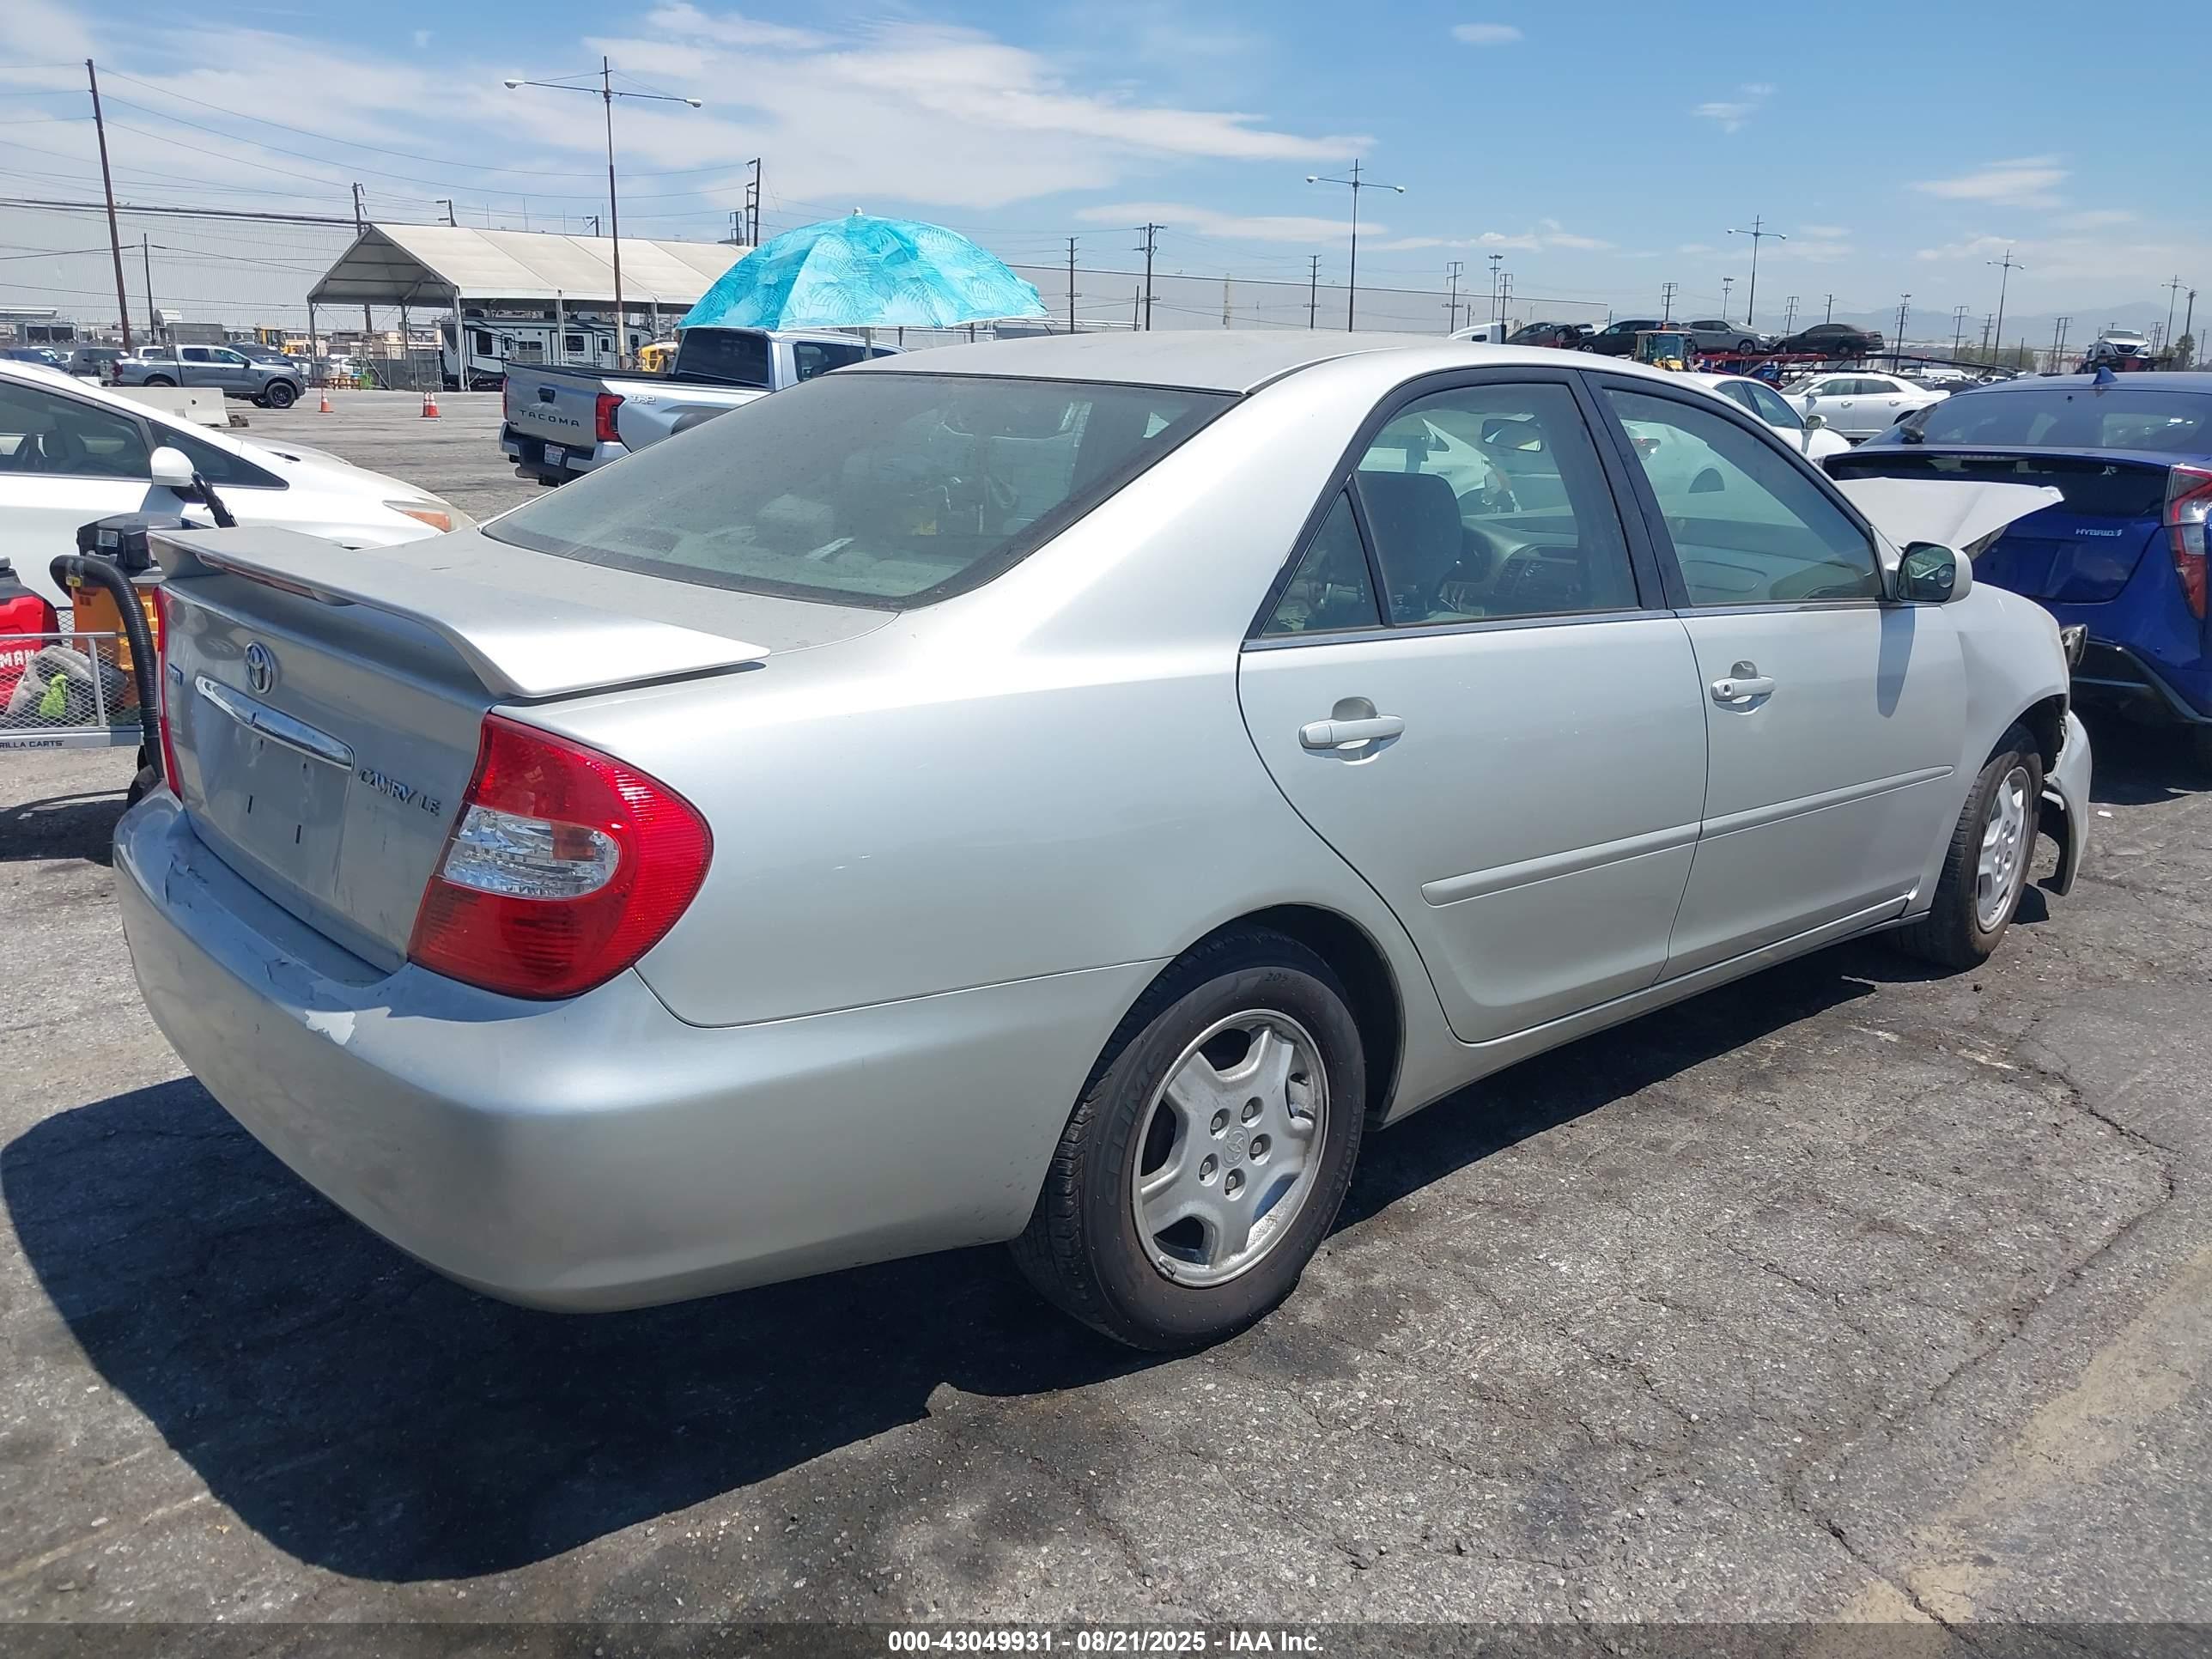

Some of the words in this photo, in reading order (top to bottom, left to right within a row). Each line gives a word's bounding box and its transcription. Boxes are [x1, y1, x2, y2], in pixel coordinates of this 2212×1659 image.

[519, 410, 580, 427] TACOMA
[28, 739, 64, 748] CARTS
[358, 768, 418, 805] CAMRY
[418, 795, 441, 817] LE
